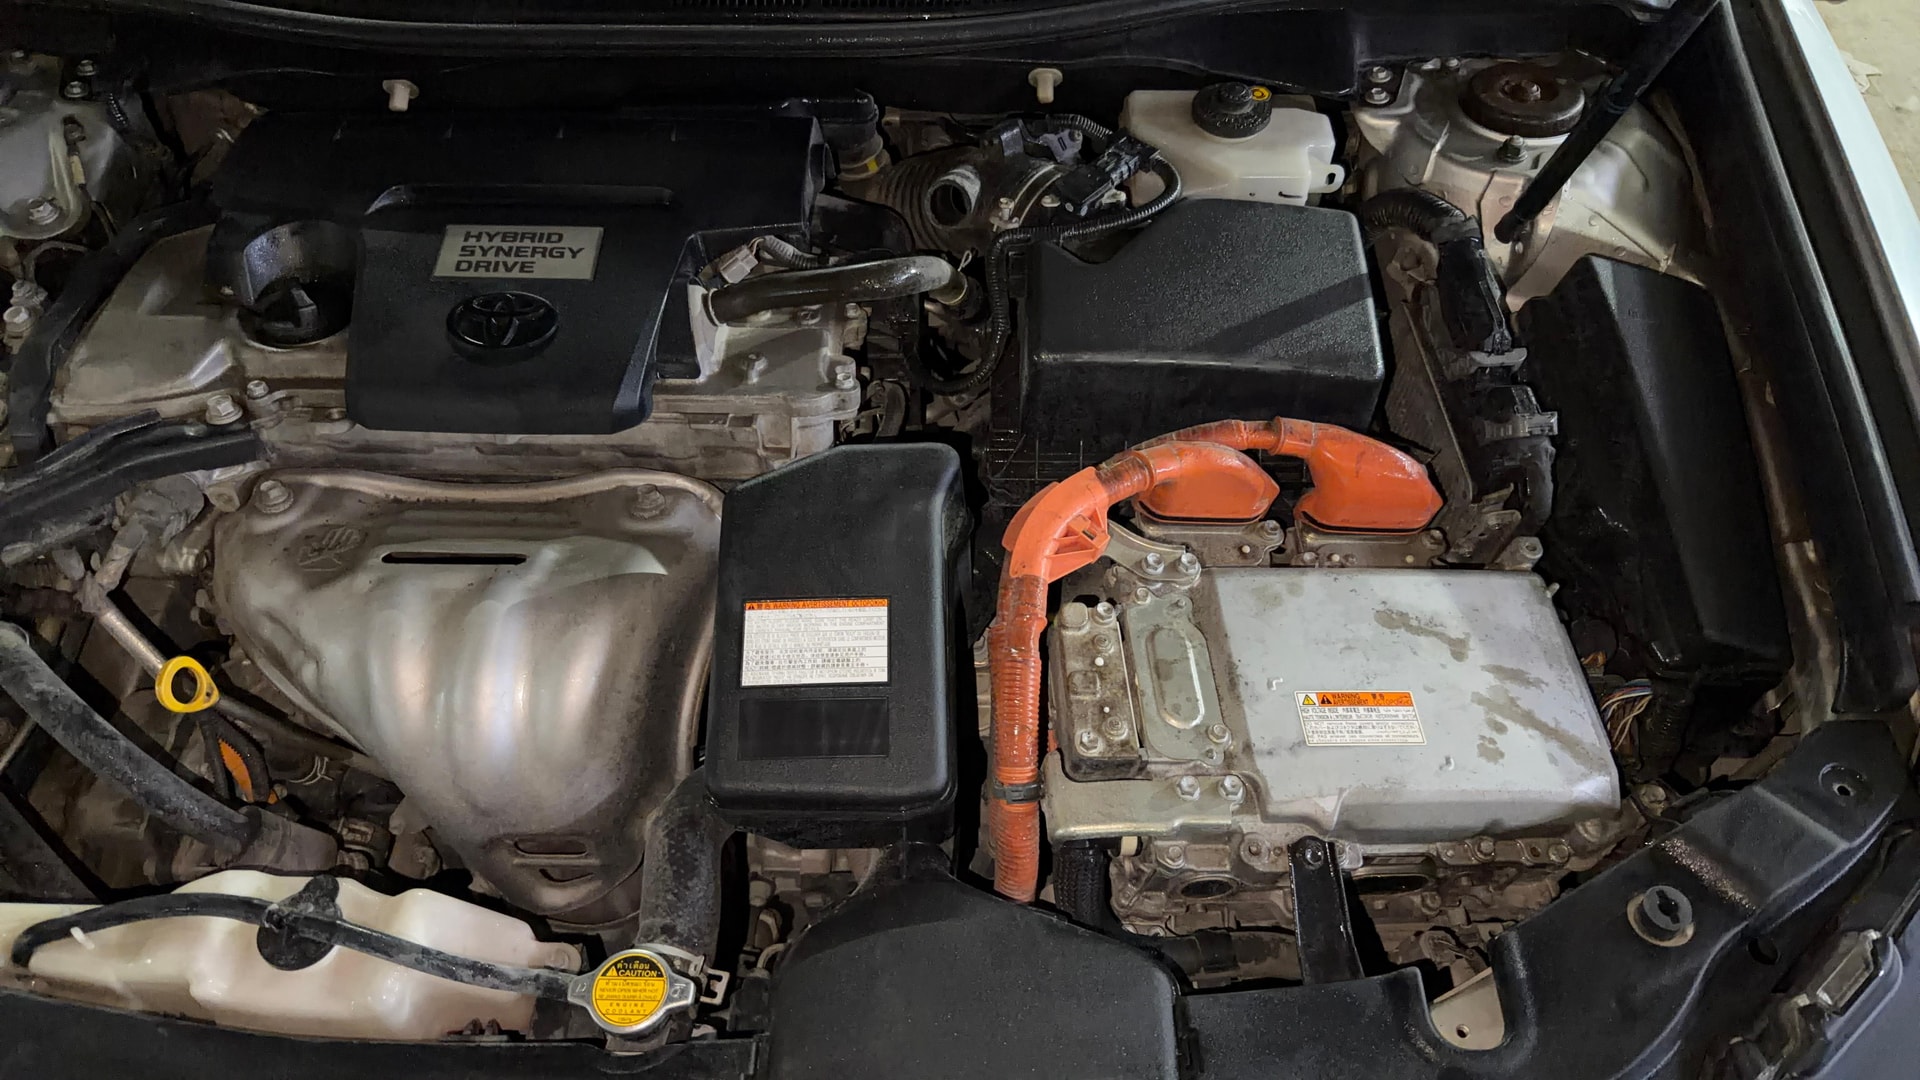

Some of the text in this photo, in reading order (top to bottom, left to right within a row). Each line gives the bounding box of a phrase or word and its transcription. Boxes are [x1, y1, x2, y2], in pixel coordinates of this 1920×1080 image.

[463, 231, 564, 244] HYBRID
[458, 245, 585, 259] SYNERGY
[454, 260, 536, 273] DRIVE
[616, 960, 650, 969] คำเตือน
